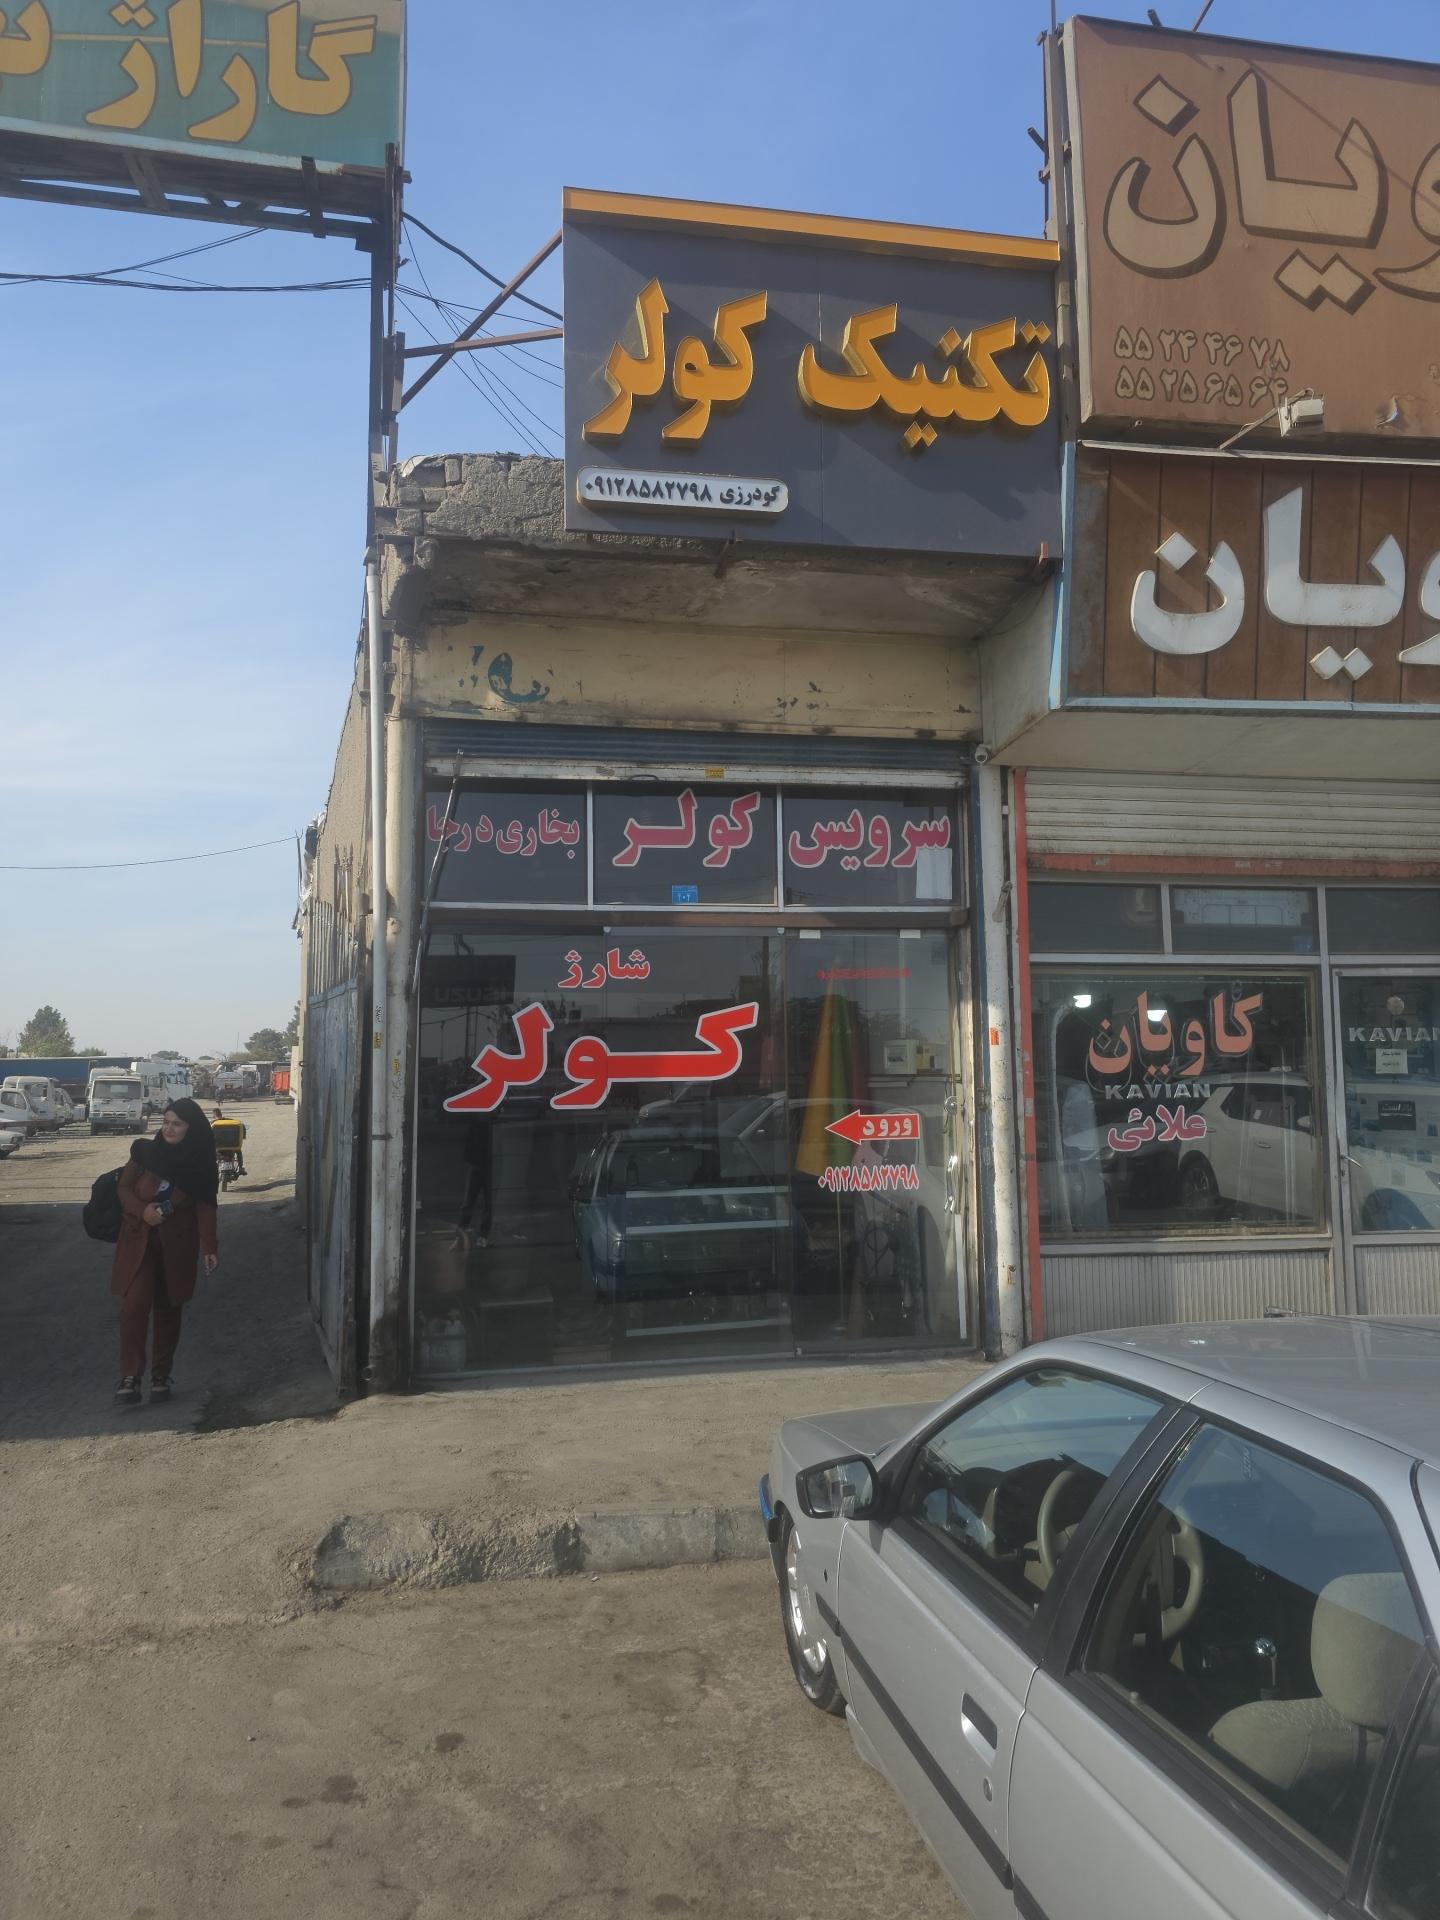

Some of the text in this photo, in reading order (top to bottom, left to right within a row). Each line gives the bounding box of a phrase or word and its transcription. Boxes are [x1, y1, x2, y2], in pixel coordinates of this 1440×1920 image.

[84, 0, 378, 144] گاراژ
[581, 277, 1053, 448] تکنیک کولر
[584, 474, 781, 508] گودرزی ۰۹۱۲۸۵۸۲۷۹۸
[495, 808, 580, 860] بخاری
[612, 787, 761, 868] کولر
[788, 808, 951, 871] سرویس
[557, 947, 651, 989] شارژ
[442, 1000, 761, 1113] کولر
[1087, 990, 1264, 1077] کاویان
[1103, 1083, 1211, 1101] KAVIAN
[862, 1117, 913, 1137] ورود
[817, 1163, 920, 1193] ۰۹۱۲۸۵۸۲۷۹۸
